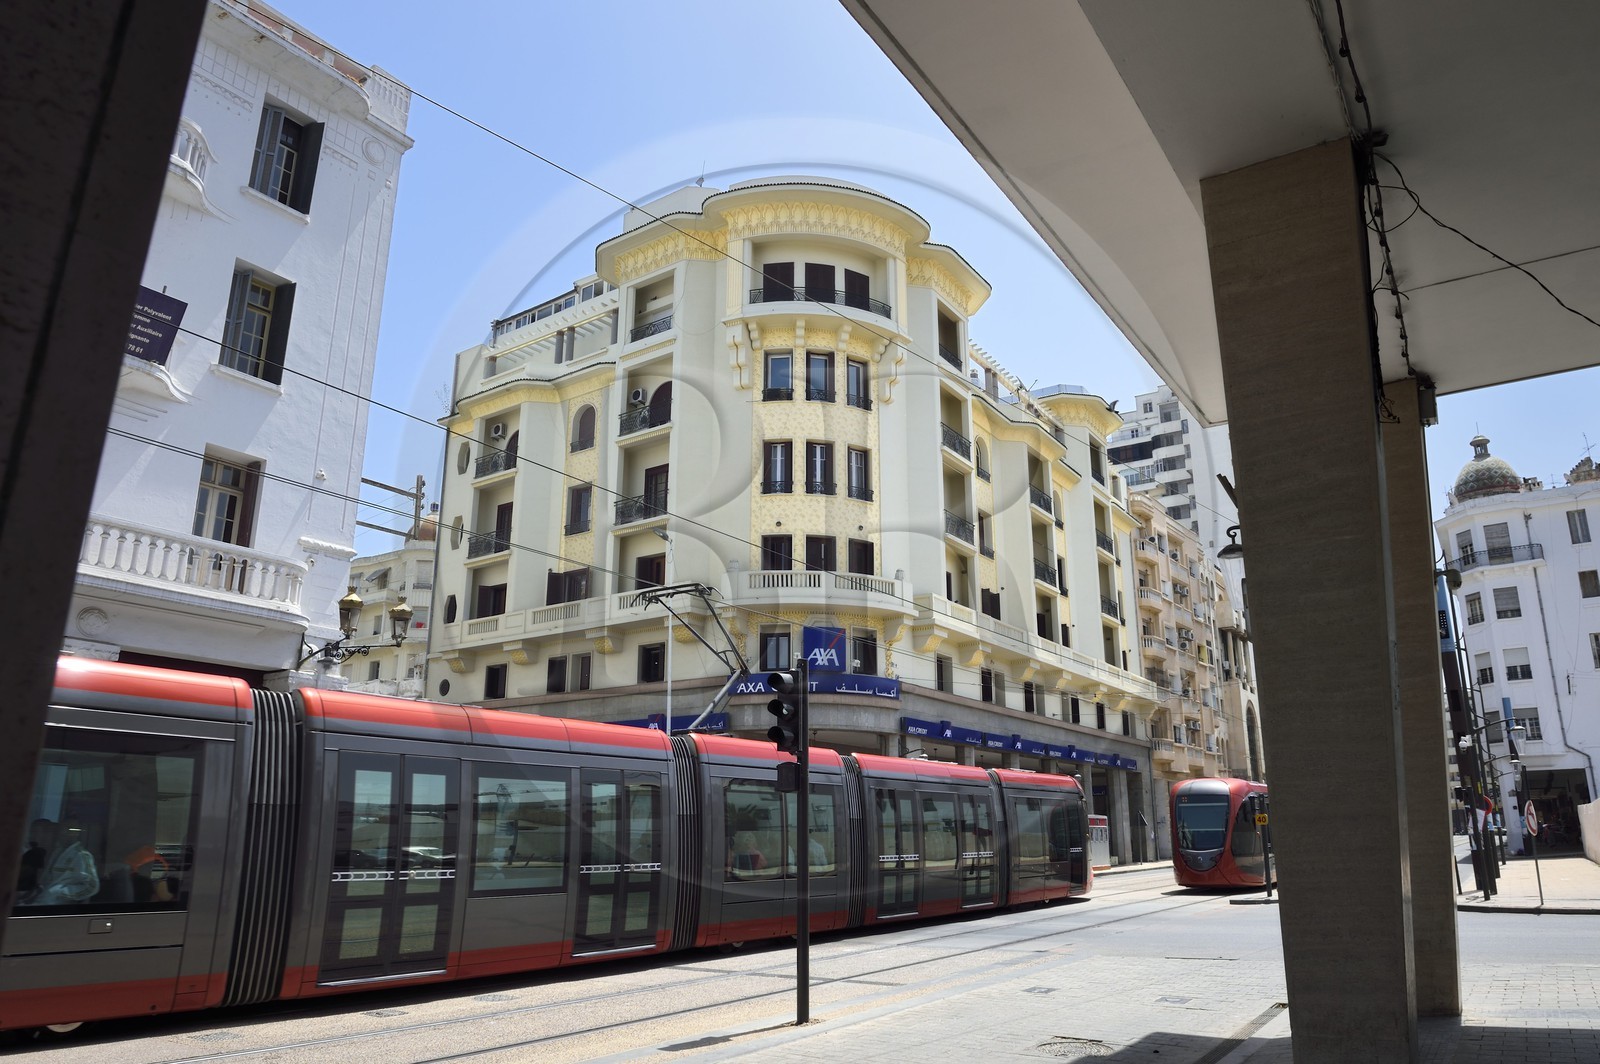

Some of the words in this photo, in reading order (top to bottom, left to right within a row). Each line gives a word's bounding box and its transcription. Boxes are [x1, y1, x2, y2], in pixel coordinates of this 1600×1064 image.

[133, 313, 150, 322] emme
[144, 306, 171, 320] Polyvalent
[137, 325, 162, 337] Auxiliaire
[808, 647, 839, 667] AXA
[737, 682, 765, 693] AXA
[1257, 815, 1267, 824] 40
